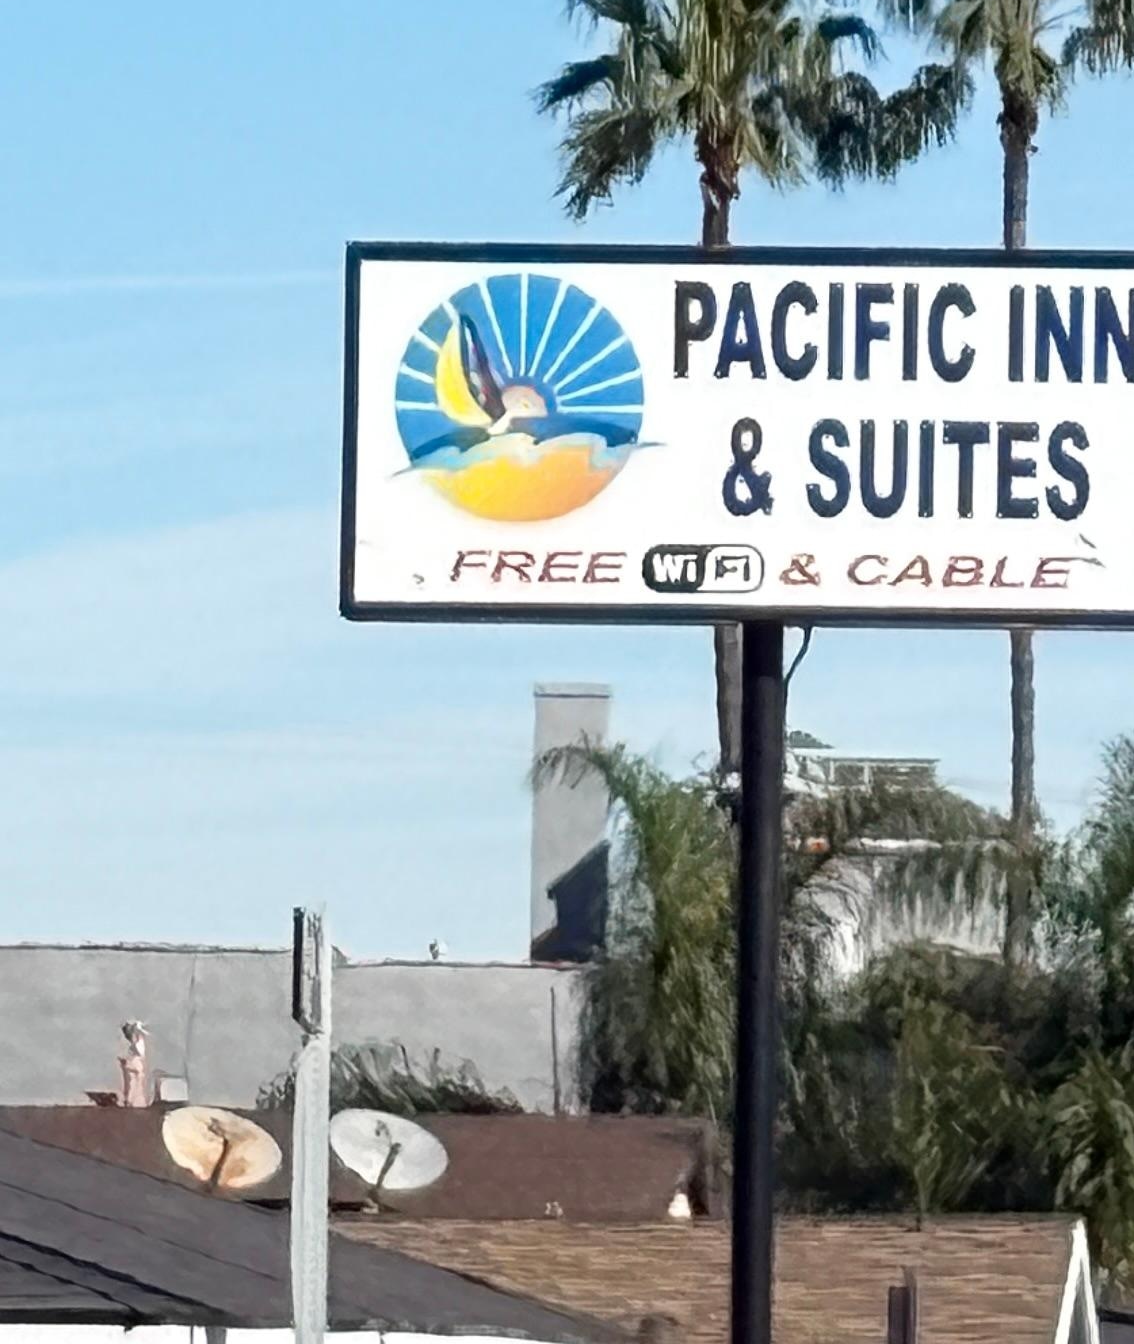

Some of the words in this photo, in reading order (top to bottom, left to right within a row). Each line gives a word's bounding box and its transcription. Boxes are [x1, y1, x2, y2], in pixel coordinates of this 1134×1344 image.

[672, 280, 976, 383] PACIFIC
[721, 416, 773, 516] &
[805, 418, 1091, 520] SUITES
[449, 550, 627, 584] FREE
[778, 554, 821, 587] &
[846, 555, 1074, 589] CABLE
